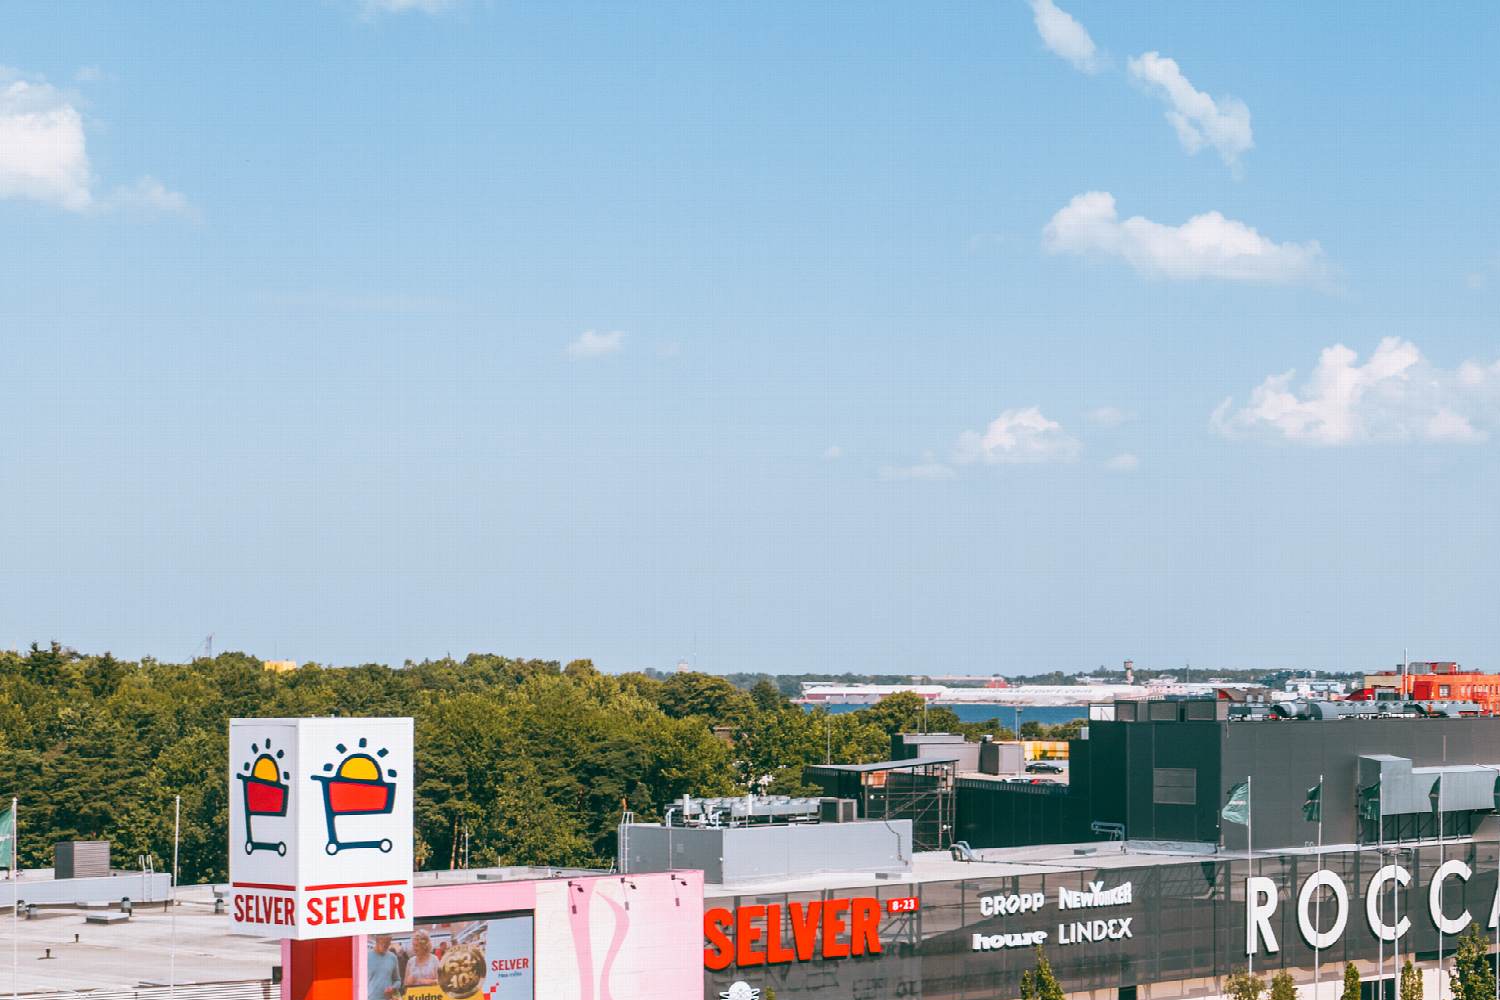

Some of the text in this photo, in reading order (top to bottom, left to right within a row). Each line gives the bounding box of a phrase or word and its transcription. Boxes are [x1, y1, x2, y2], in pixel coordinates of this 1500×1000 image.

[234, 894, 296, 926] SELVER
[306, 892, 406, 926] SELVER
[980, 892, 1045, 917] CROPP
[704, 897, 883, 971] SELVER
[972, 930, 1048, 950] house
[1058, 917, 1133, 945] LINDEX
[491, 958, 529, 972] SELVER
